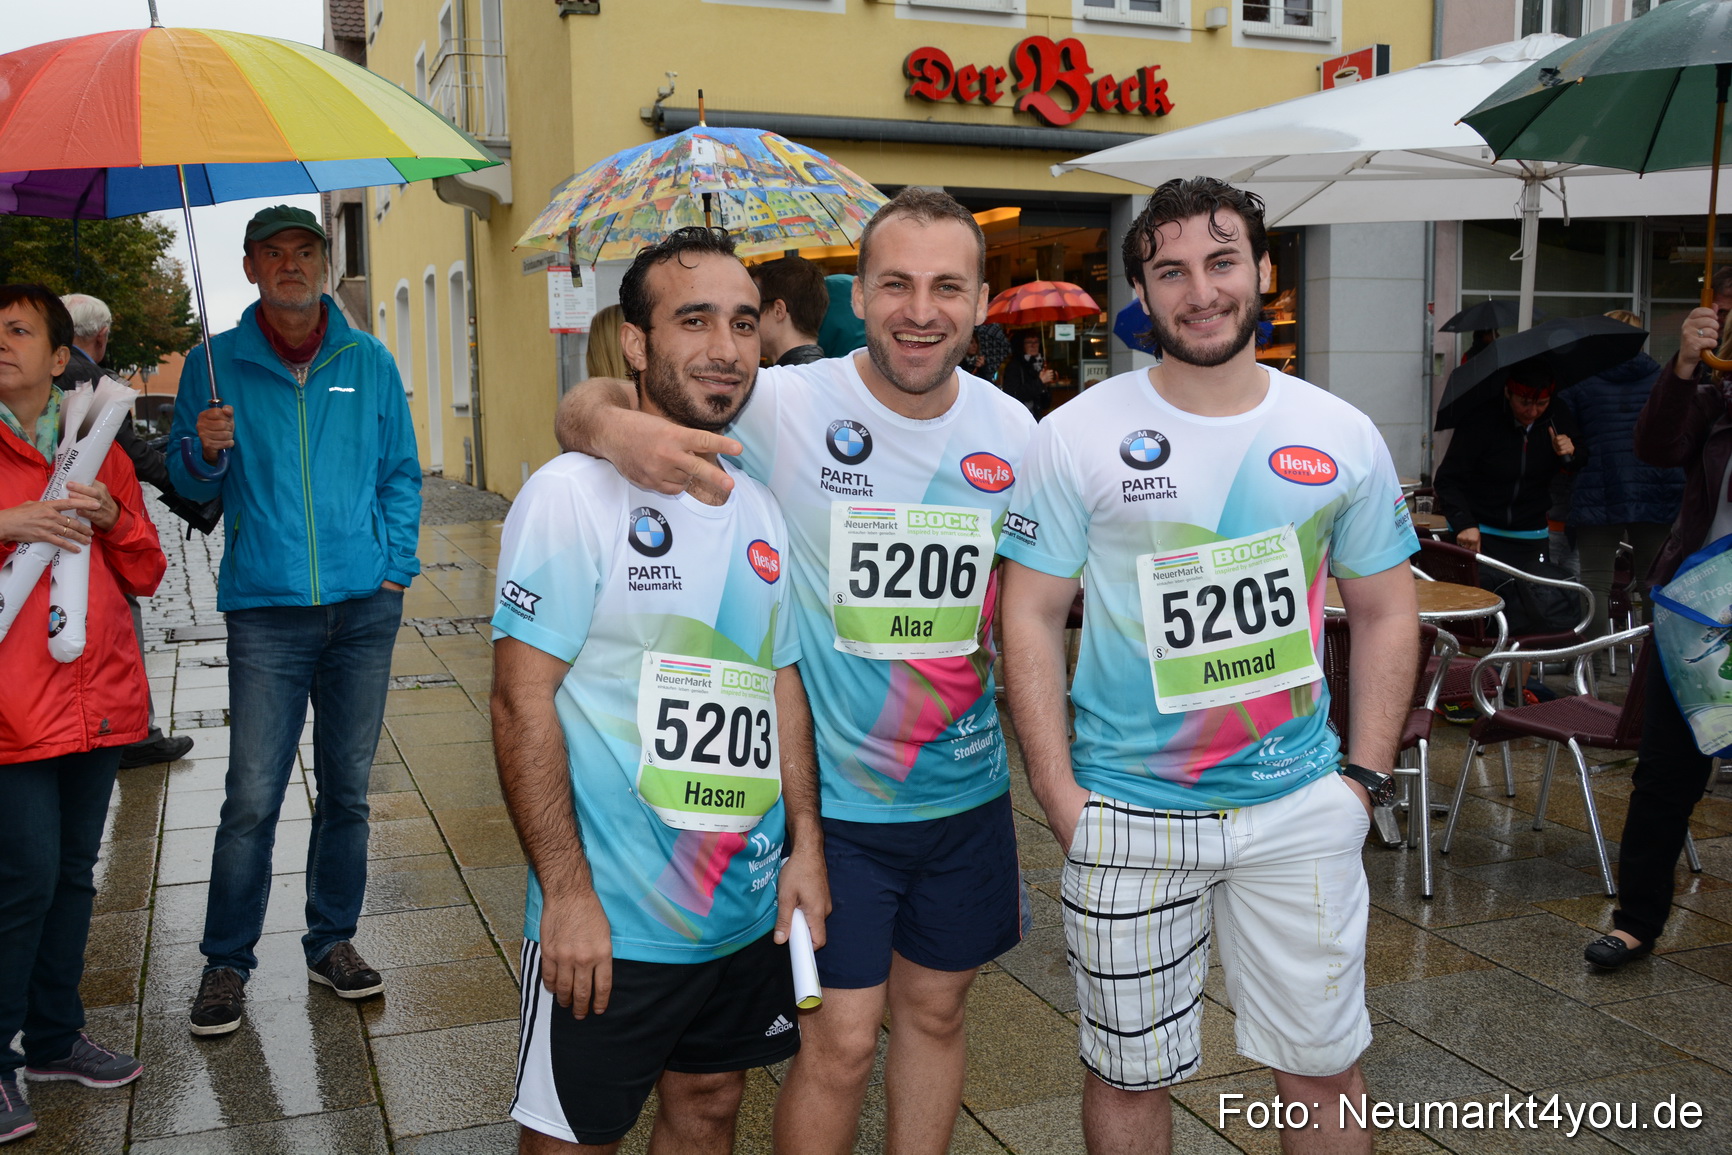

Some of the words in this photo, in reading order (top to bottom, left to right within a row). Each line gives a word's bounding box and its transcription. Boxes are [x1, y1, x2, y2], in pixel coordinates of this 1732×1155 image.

[903, 46, 1007, 106] Der
[1009, 35, 1175, 126] Beck
[1087, 367, 1104, 376] JETZT
[62, 449, 79, 473] BMW
[1279, 453, 1331, 475] Hervis
[821, 467, 873, 487] PARTL
[966, 462, 1010, 485] Hervis
[820, 480, 873, 497] Neumarkt
[1122, 477, 1177, 493] PARTL
[1123, 490, 1178, 503] Neumarkt
[846, 520, 898, 530] NeuerMarkt
[907, 510, 979, 532] BOCK
[907, 529, 930, 537] inspired
[1211, 534, 1287, 568] BOCK
[628, 566, 682, 580] PARTL
[849, 543, 979, 600] 5206
[1153, 565, 1204, 580] NeuerMarkt
[1684, 564, 1718, 587] kommt
[628, 580, 683, 592] Neumarkt
[1163, 568, 1296, 649] 5205
[890, 615, 934, 637] Alaa
[1203, 648, 1276, 684] Ahmad
[655, 674, 713, 688] NeuerMarkt
[722, 668, 770, 694] BOCK
[655, 698, 772, 769] 5203
[954, 730, 993, 761] Stadtlauf
[685, 781, 745, 808] Hasan
[765, 1021, 793, 1037] adidas
